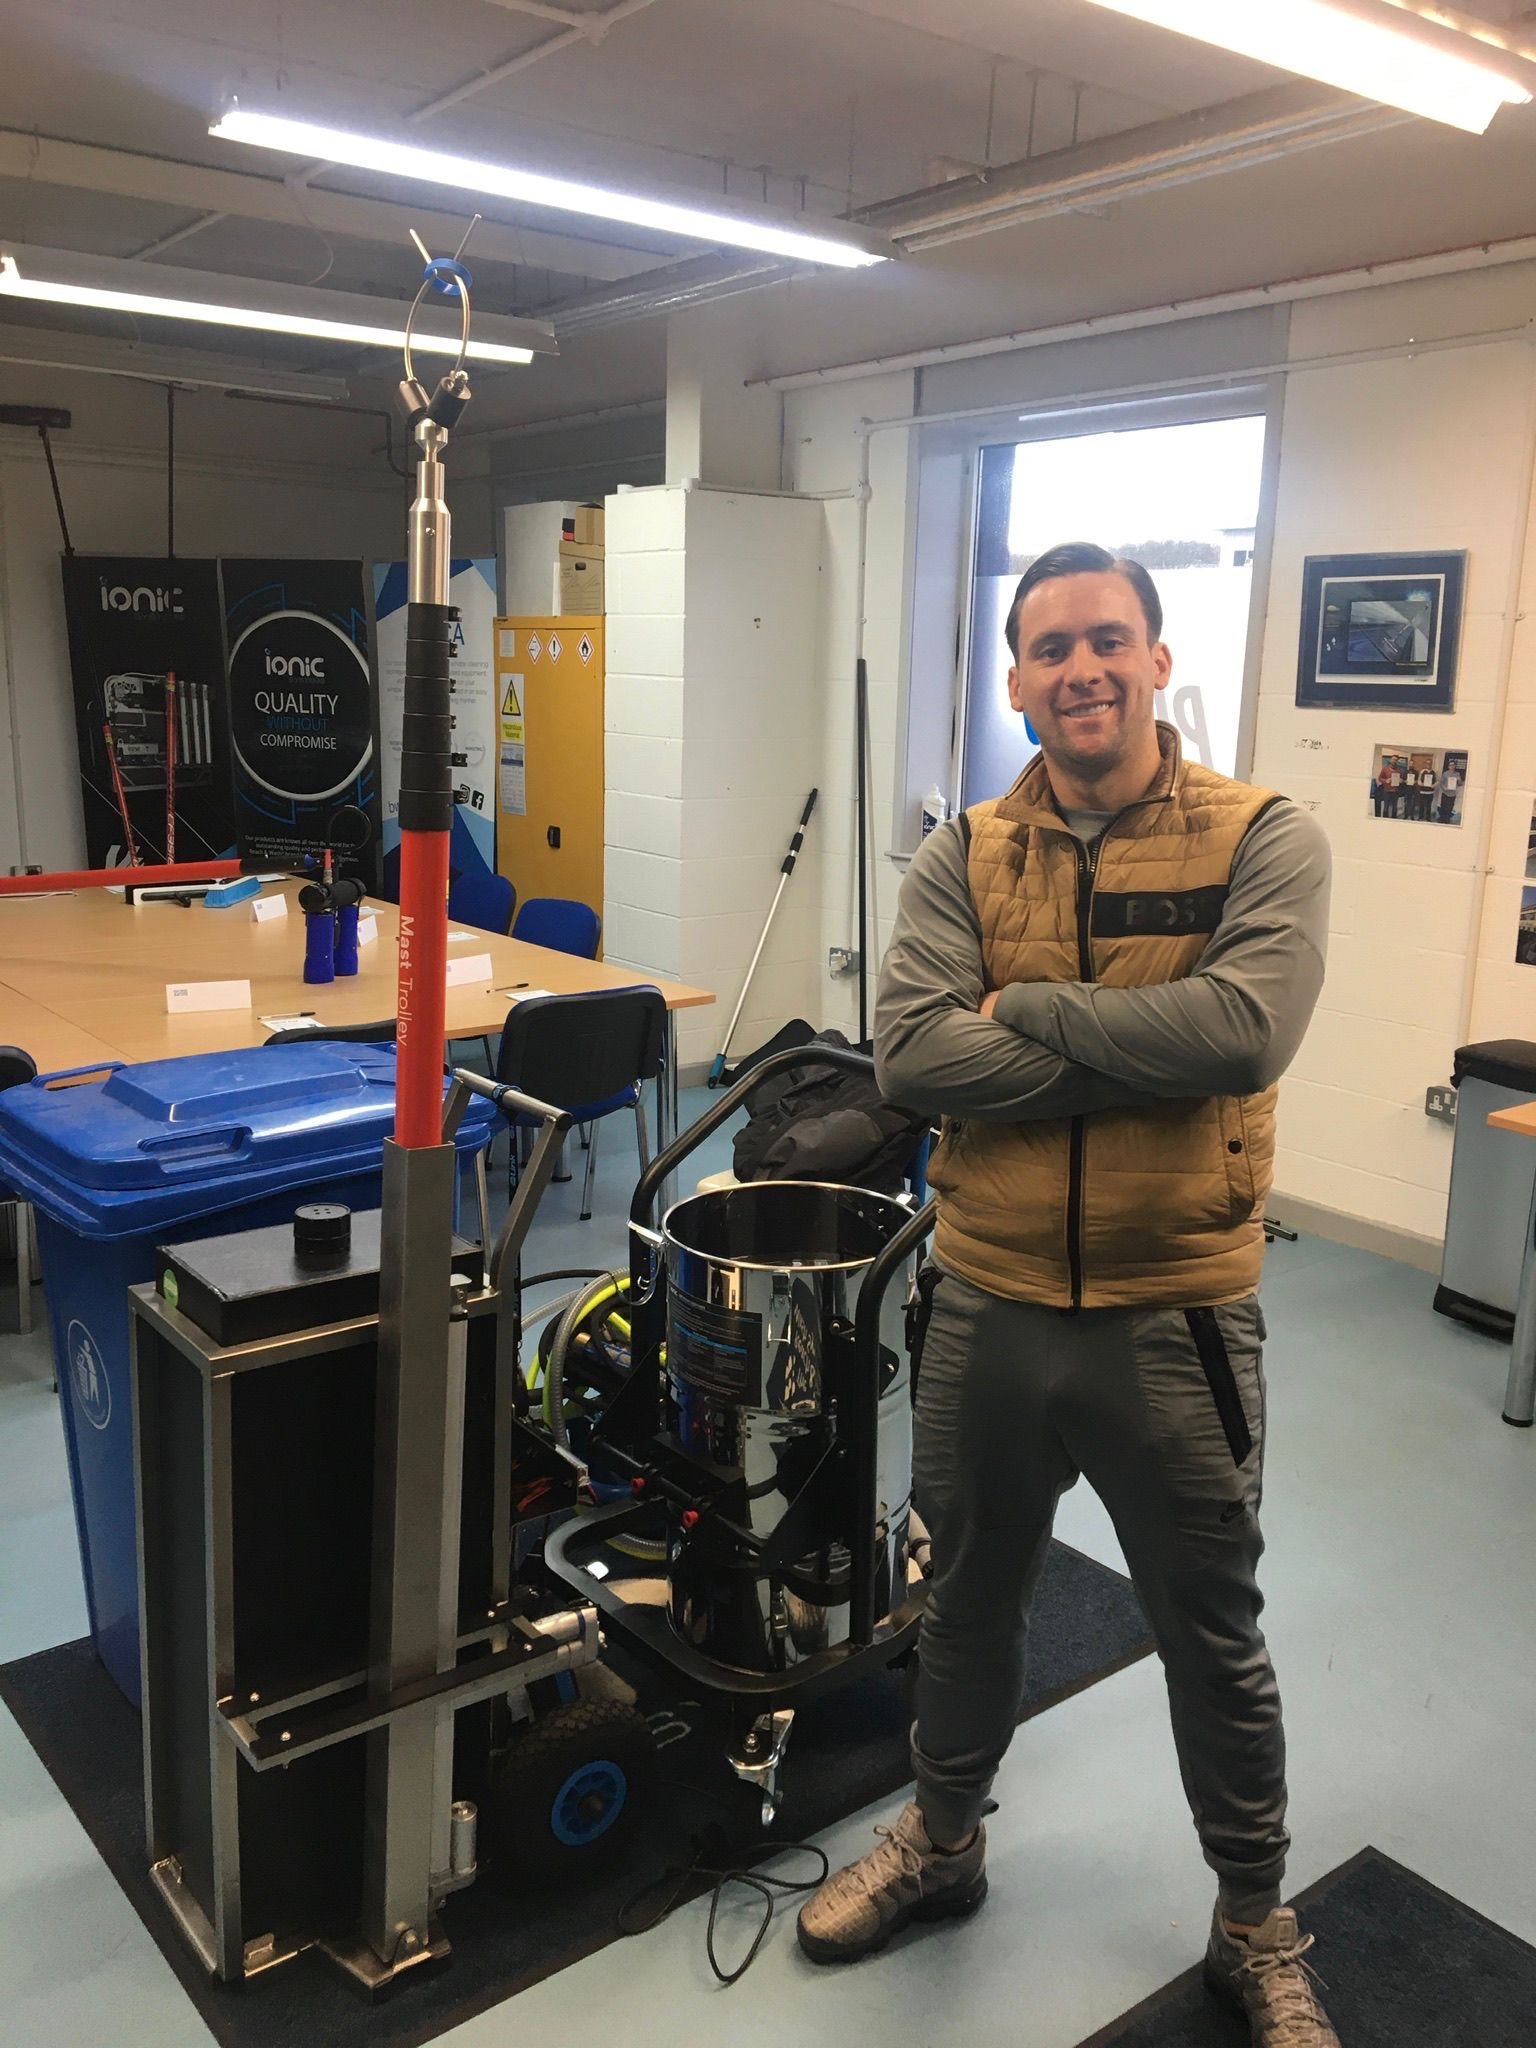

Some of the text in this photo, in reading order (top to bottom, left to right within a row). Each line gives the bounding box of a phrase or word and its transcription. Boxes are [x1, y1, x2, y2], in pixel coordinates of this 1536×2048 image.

[265, 648, 325, 678] ionic
[254, 691, 339, 715] QUALITY
[268, 715, 329, 731] WITHOUT
[260, 733, 337, 750] COMPROMISE
[398, 915, 415, 1047] Mast Trolley
